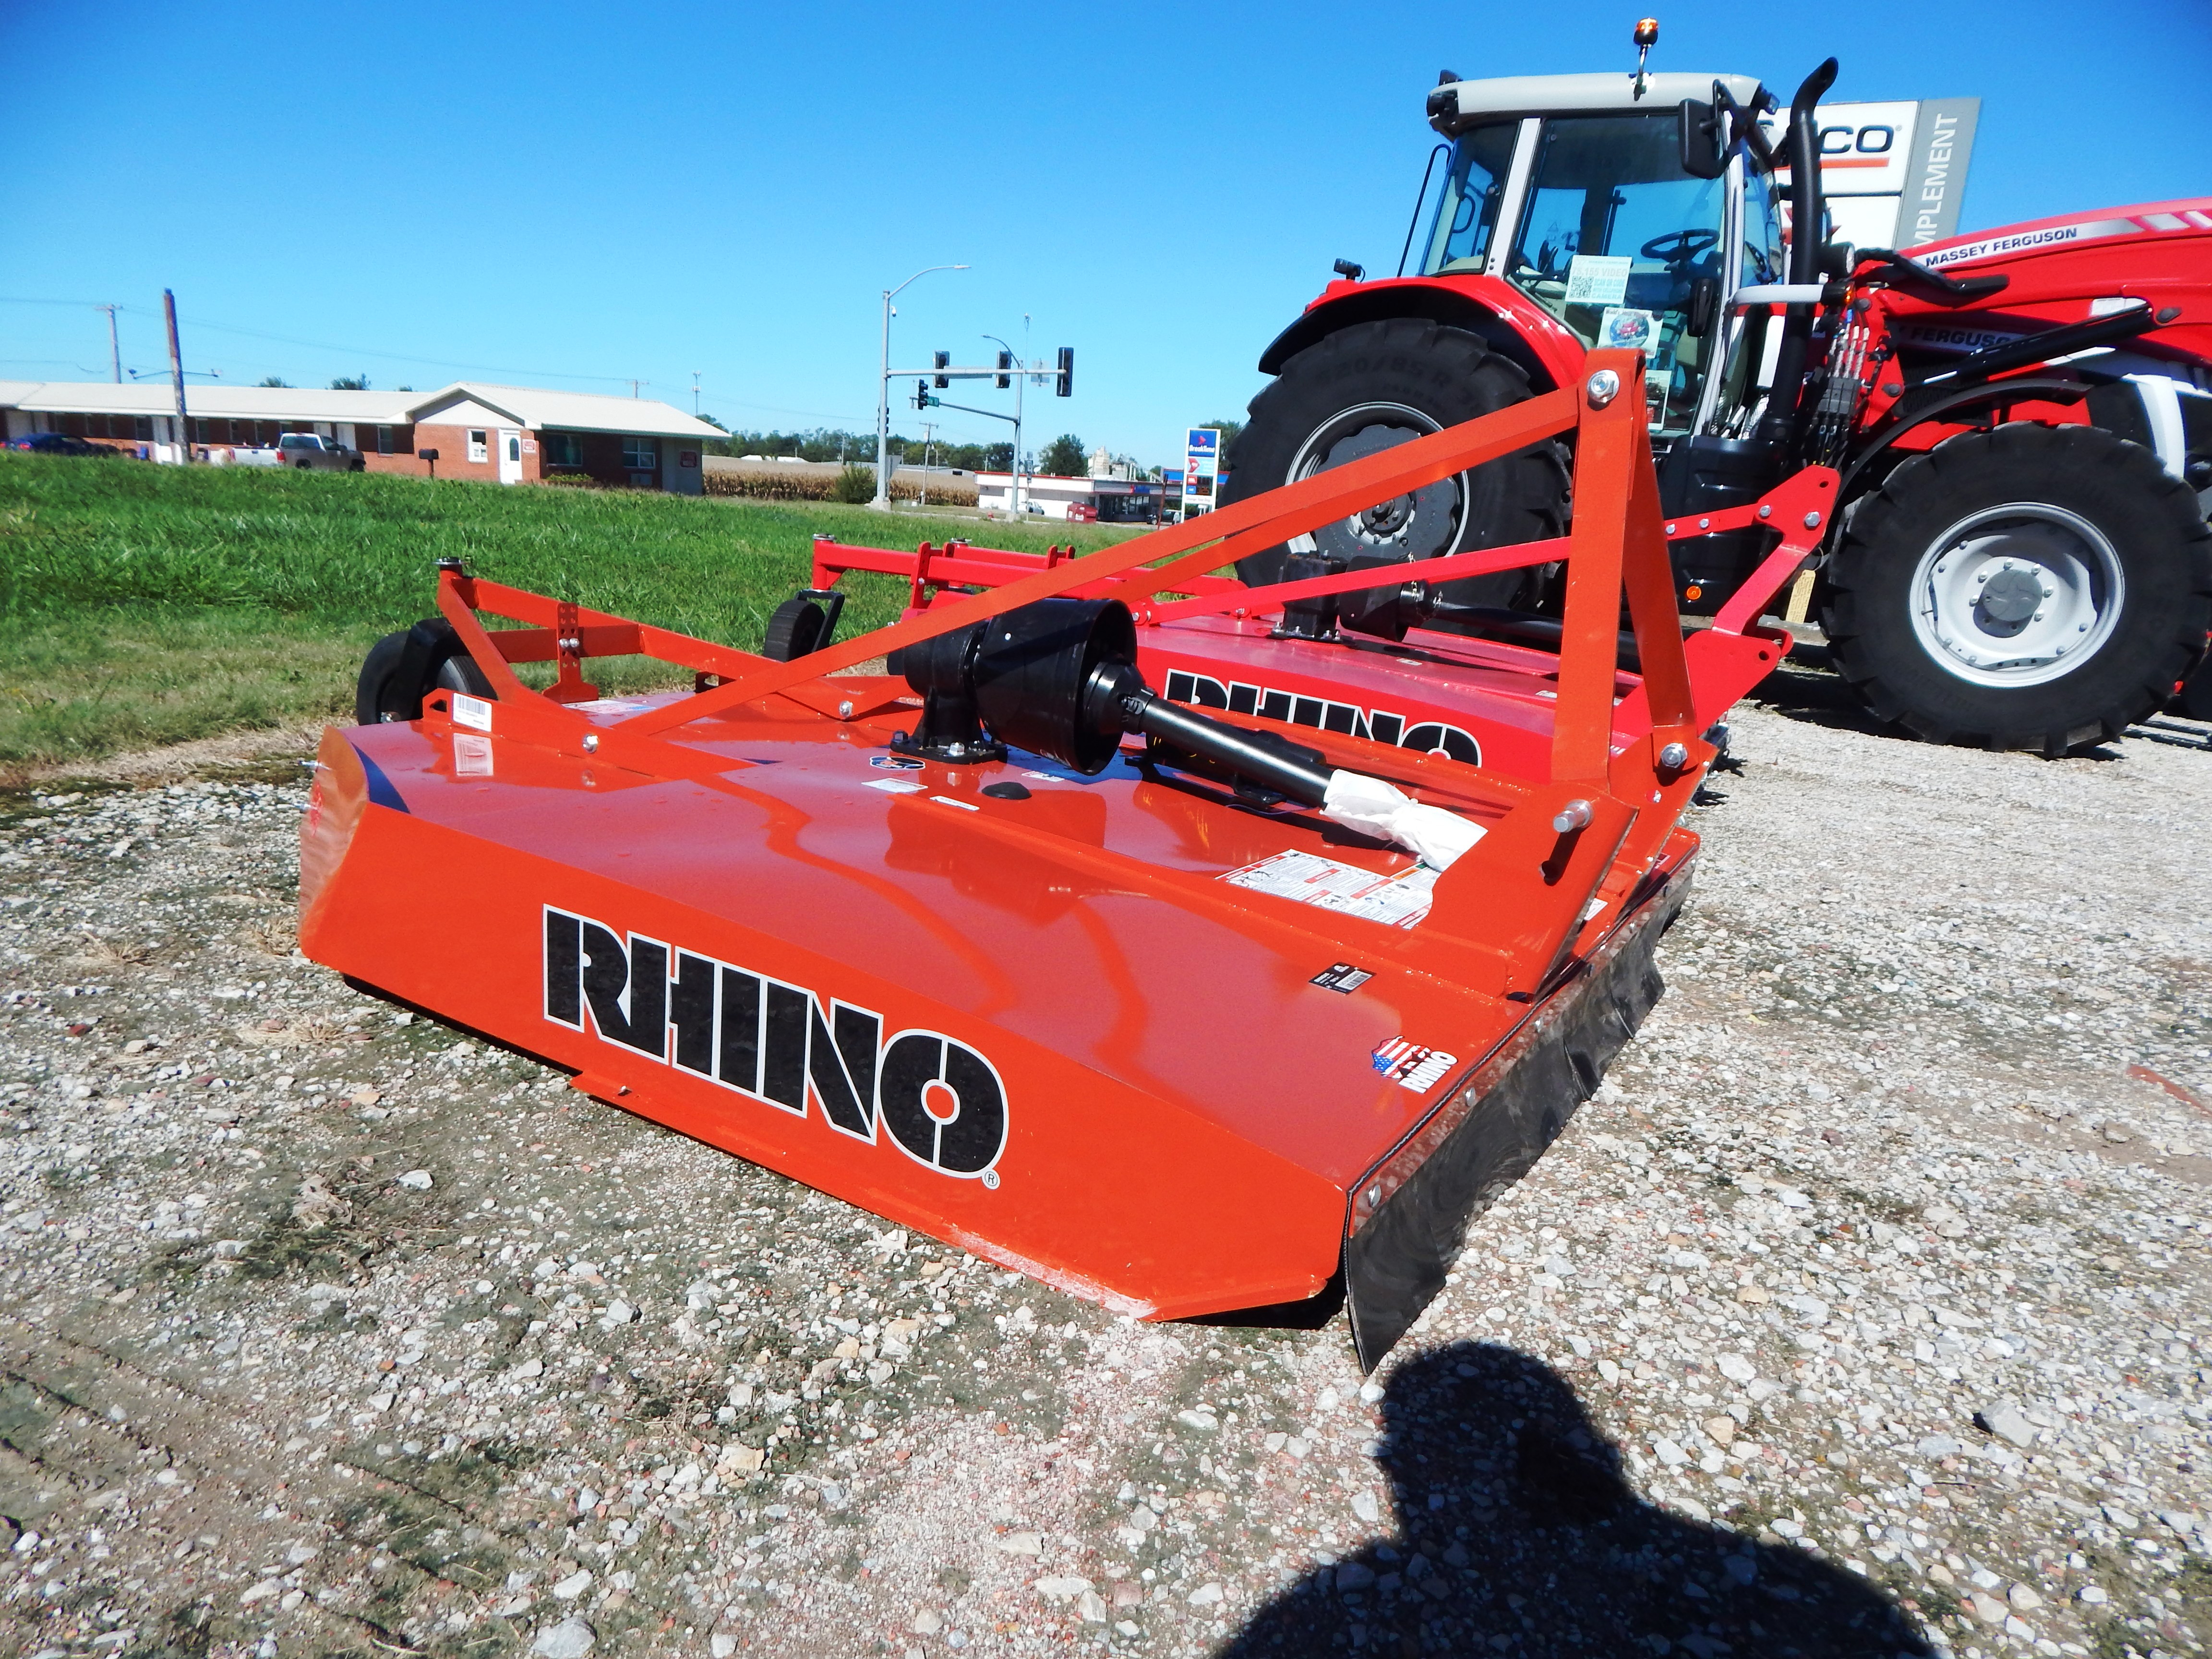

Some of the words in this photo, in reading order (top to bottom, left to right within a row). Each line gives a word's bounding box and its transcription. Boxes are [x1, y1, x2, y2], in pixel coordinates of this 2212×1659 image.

[1819, 125, 1894, 154] CO
[1912, 113, 1958, 247] MPLEMENT
[1925, 244, 1988, 267] MASSEY
[1994, 228, 2077, 252] FERGUSON
[1602, 268, 1628, 277] VIDEO
[1911, 326, 2010, 348] FERGUS
[543, 903, 1010, 1179] RHINO
[1398, 1051, 1458, 1094] RHINO
